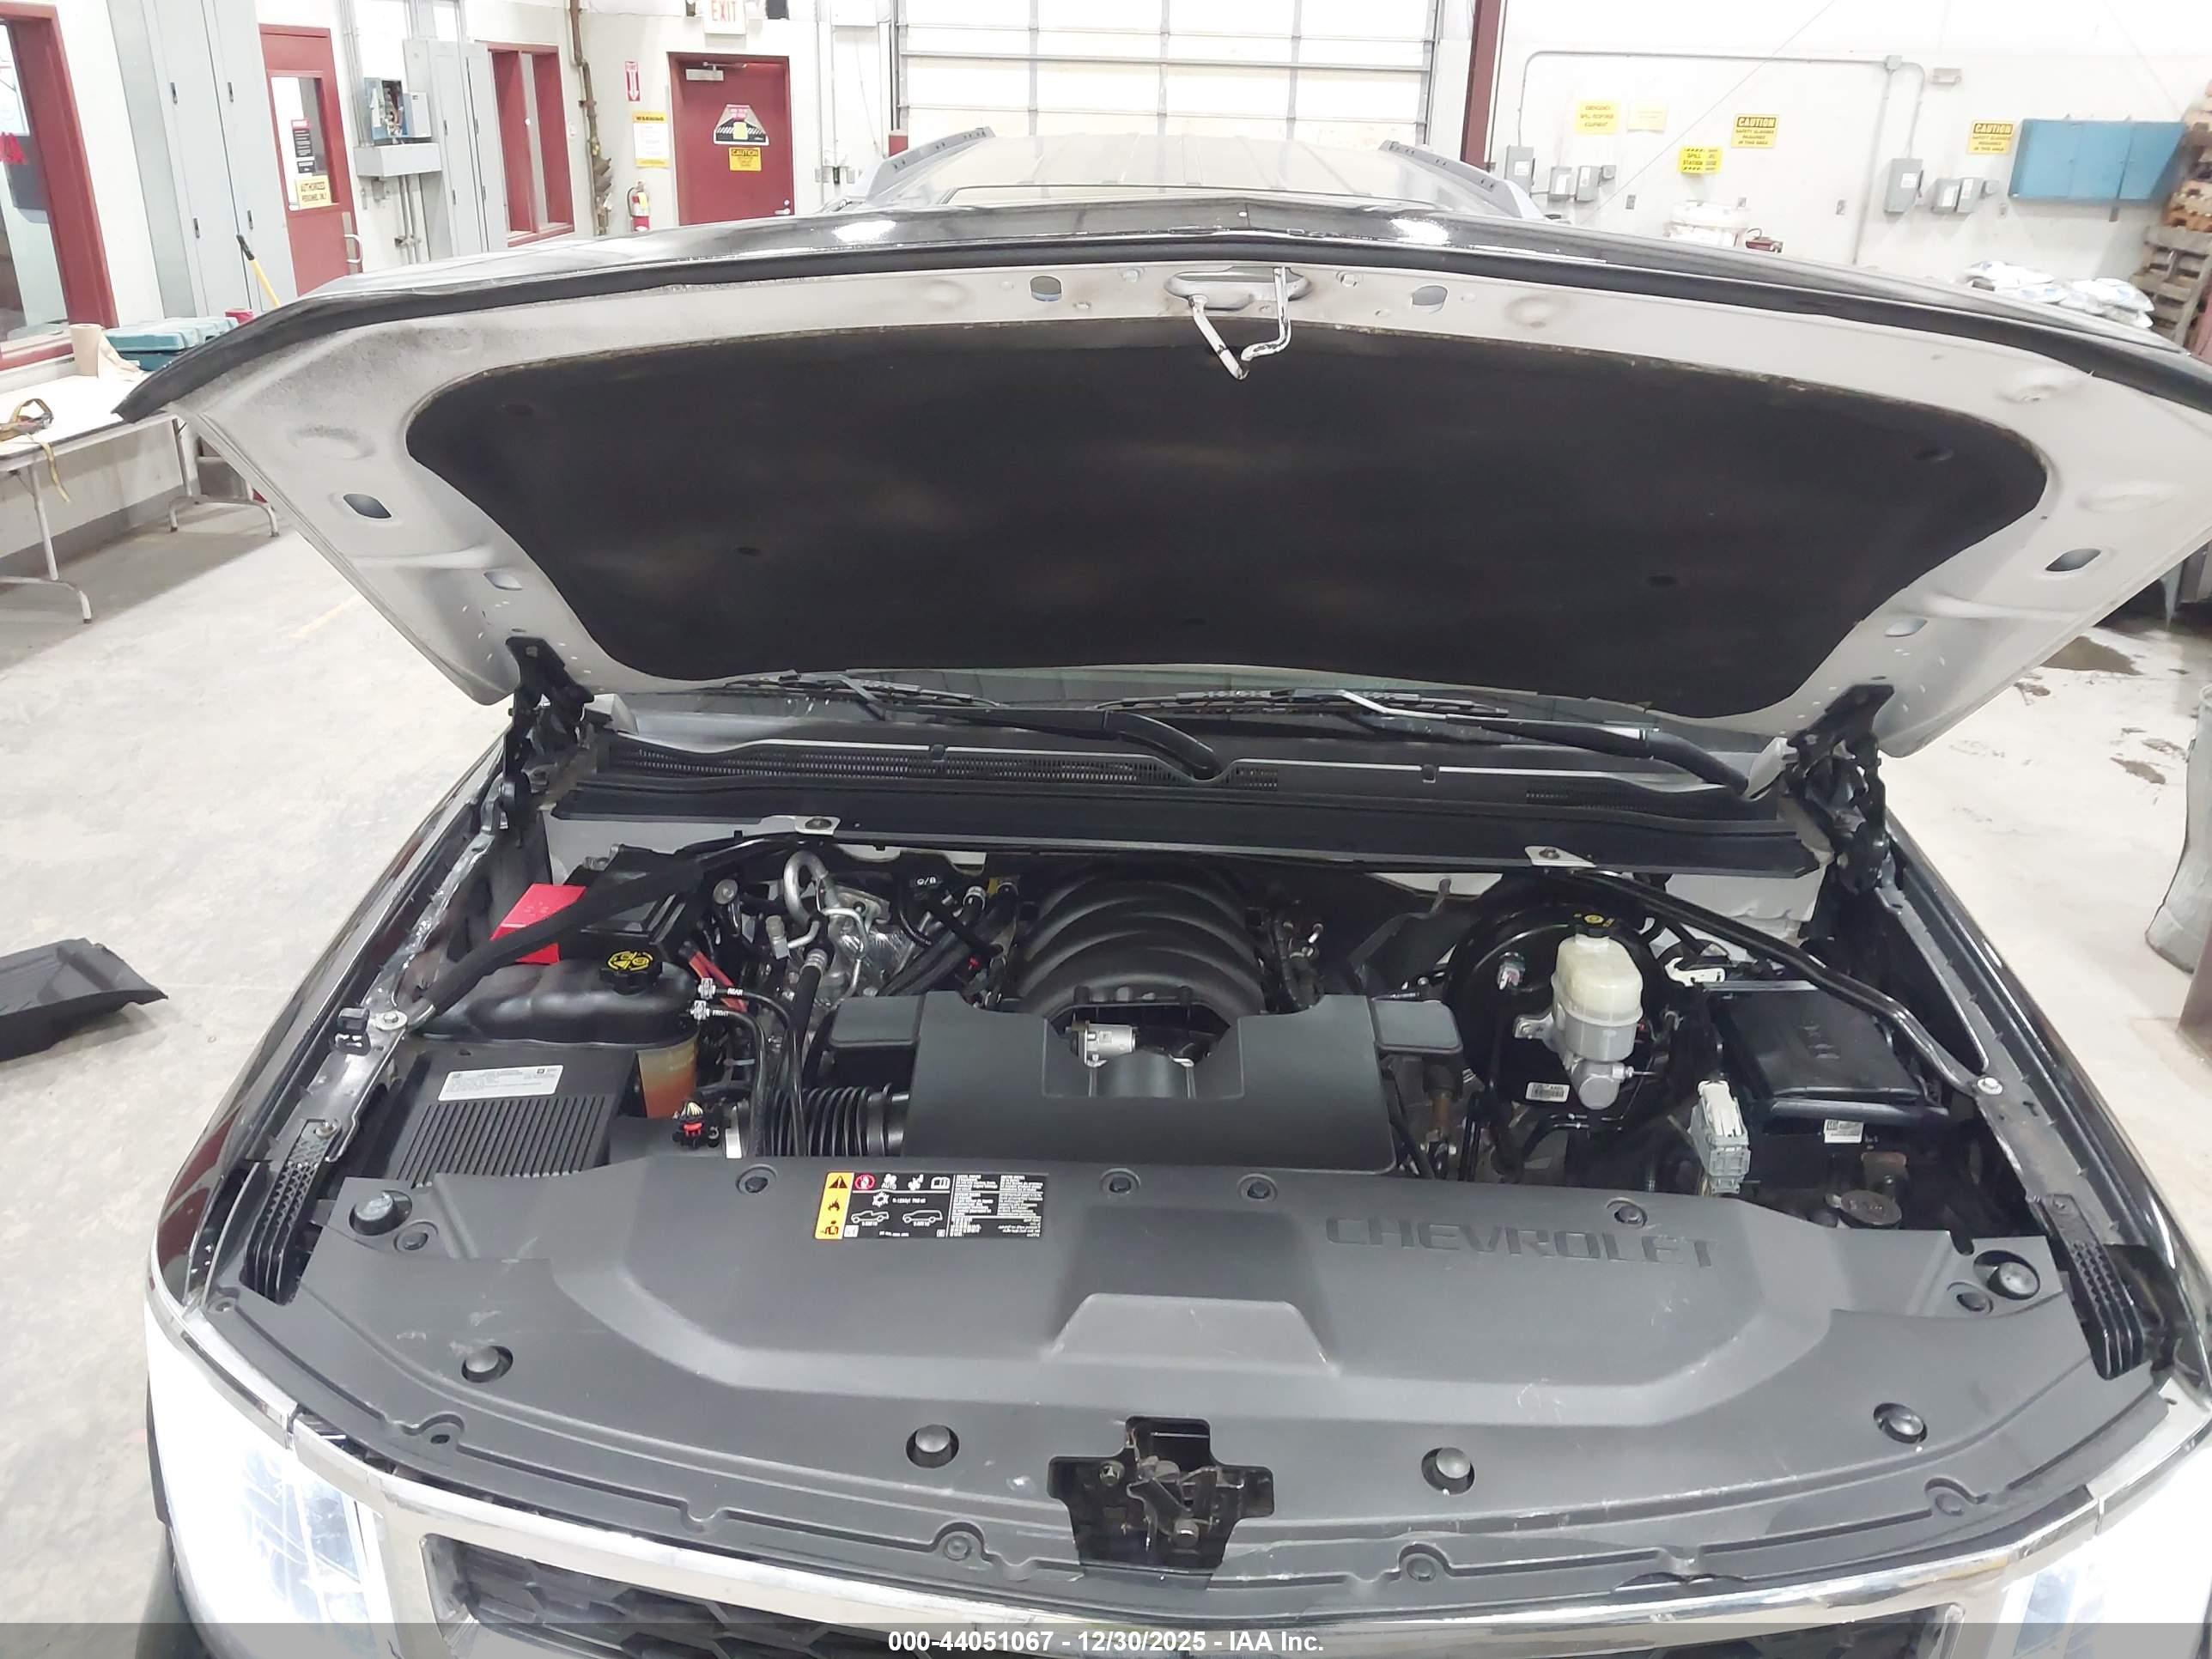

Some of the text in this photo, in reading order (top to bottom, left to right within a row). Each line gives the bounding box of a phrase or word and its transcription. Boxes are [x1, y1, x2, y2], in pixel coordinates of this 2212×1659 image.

[711, 0, 737, 22] EXIT
[1737, 117, 1776, 128] CAUTION
[1974, 124, 2012, 134] CAUTION
[727, 988, 744, 996] REAR
[1325, 1217, 1719, 1268] CHEVROLET
